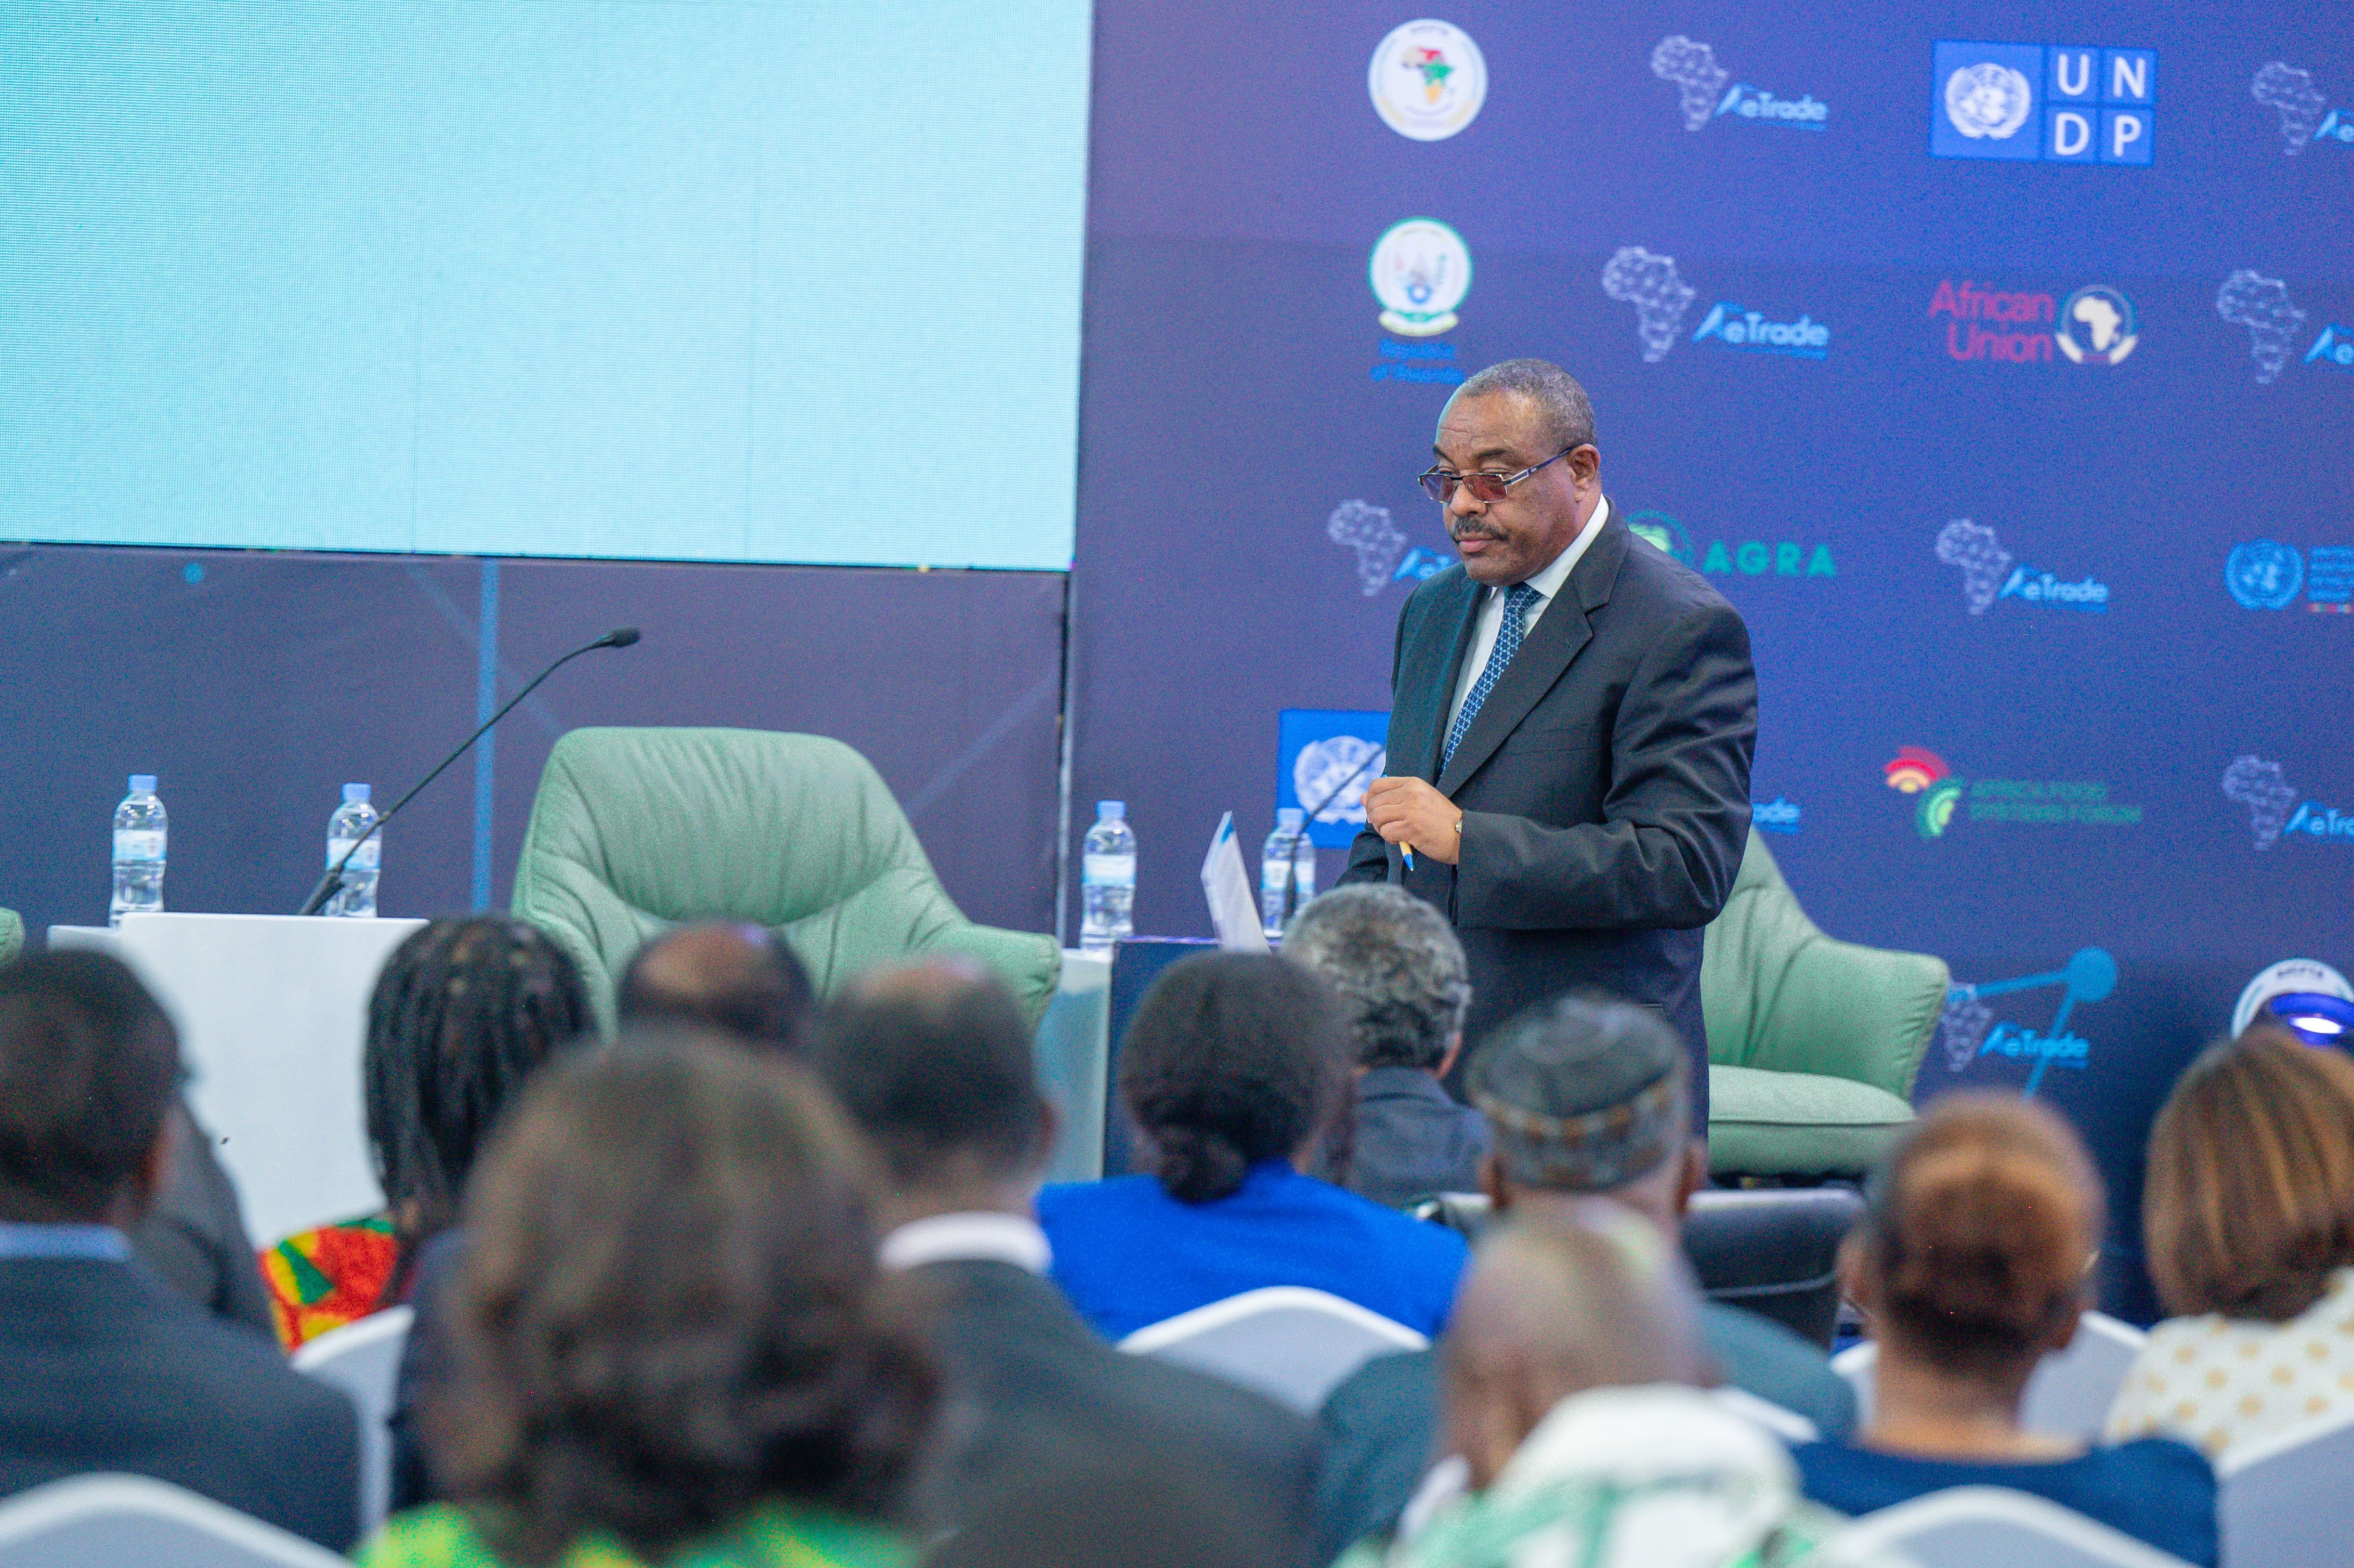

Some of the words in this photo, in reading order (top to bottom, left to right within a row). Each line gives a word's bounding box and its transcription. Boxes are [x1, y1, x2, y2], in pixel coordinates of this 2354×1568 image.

[1928, 280, 2055, 322] African
[1947, 319, 2054, 363] Union
[1702, 540, 1836, 577] AGRA
